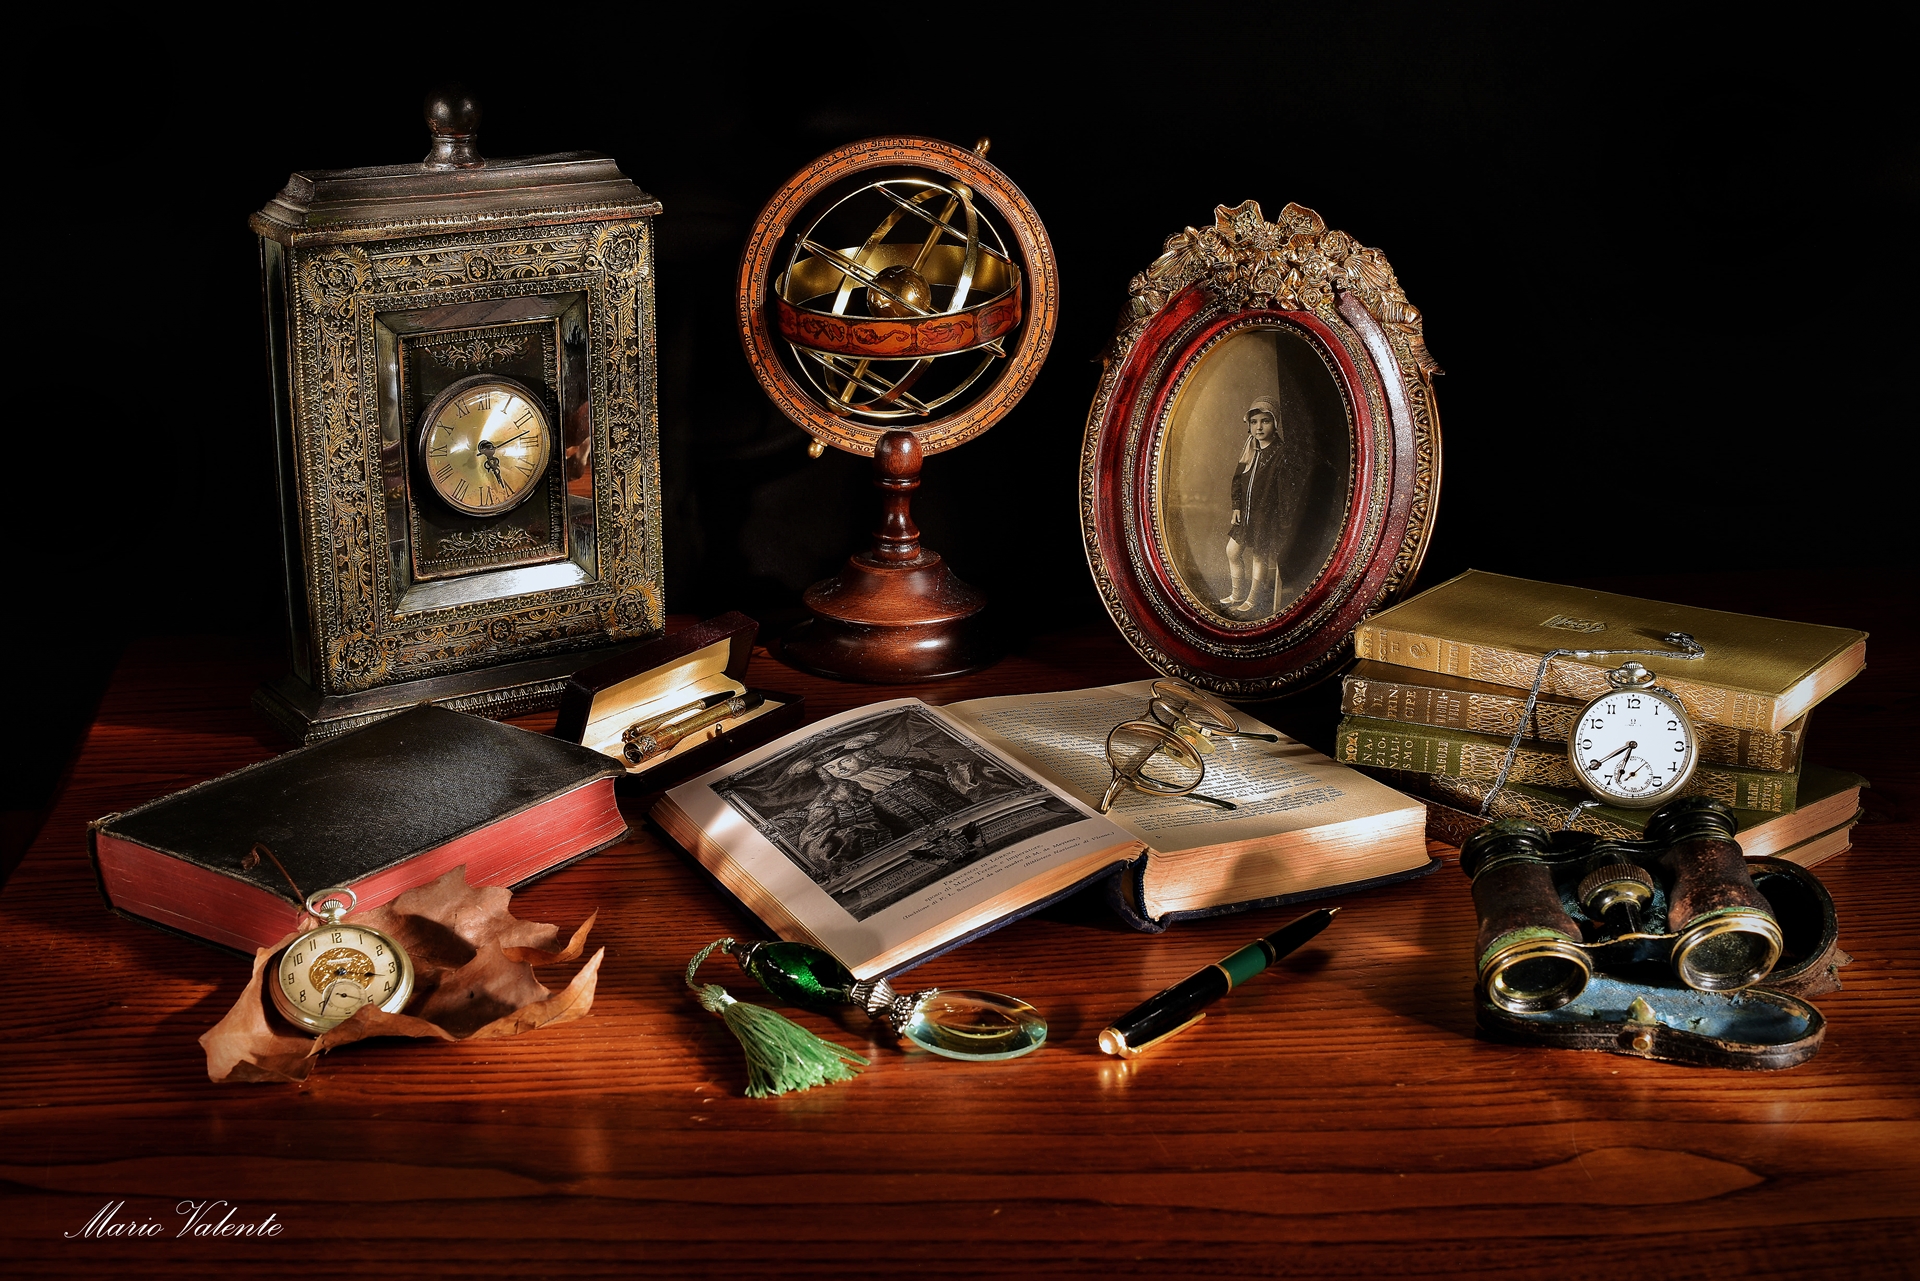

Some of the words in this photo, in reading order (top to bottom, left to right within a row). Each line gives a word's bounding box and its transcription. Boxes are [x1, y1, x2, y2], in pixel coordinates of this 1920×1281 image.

[922, 141, 954, 153] ZONA
[810, 153, 839, 172] ZONA
[745, 230, 761, 265] ZONA
[760, 184, 793, 225] TORRIDA
[1033, 330, 1049, 364] ZONA
[754, 360, 773, 389] ZONA
[478, 392, 491, 410] XII
[500, 394, 514, 414] I
[454, 398, 470, 418] XI
[514, 410, 534, 429] II
[437, 421, 454, 436] X
[953, 423, 982, 442] ZONA
[520, 435, 539, 448] III
[429, 445, 447, 458] IX
[436, 464, 454, 484] VIII
[452, 479, 469, 502] VII
[479, 486, 494, 506] VI
[1372, 695, 1383, 708] IL
[1405, 690, 1416, 718] CIPE
[1628, 698, 1640, 708] 12
[1449, 700, 1460, 720] VELLI
[1607, 704, 1616, 714] 11
[1654, 706, 1658, 715] 1
[1590, 719, 1604, 729] 10
[1667, 720, 1677, 731] 2
[1674, 741, 1684, 752] 3
[1403, 740, 1413, 769] SMO
[1667, 762, 1676, 772] 4
[1604, 775, 1613, 785] 7
[1652, 776, 1662, 787] 5
[925, 892, 942, 902] sposo
[954, 876, 974, 887] Maria
[309, 939, 316, 951] 11
[331, 933, 342, 944] 12
[360, 934, 362, 944] 1
[376, 945, 383, 956] 2
[293, 953, 303, 966] 10
[388, 962, 395, 974] 3
[288, 973, 295, 984] 9
[383, 981, 392, 992] 4
[300, 990, 306, 1002] 8
[367, 994, 374, 1004] 5
